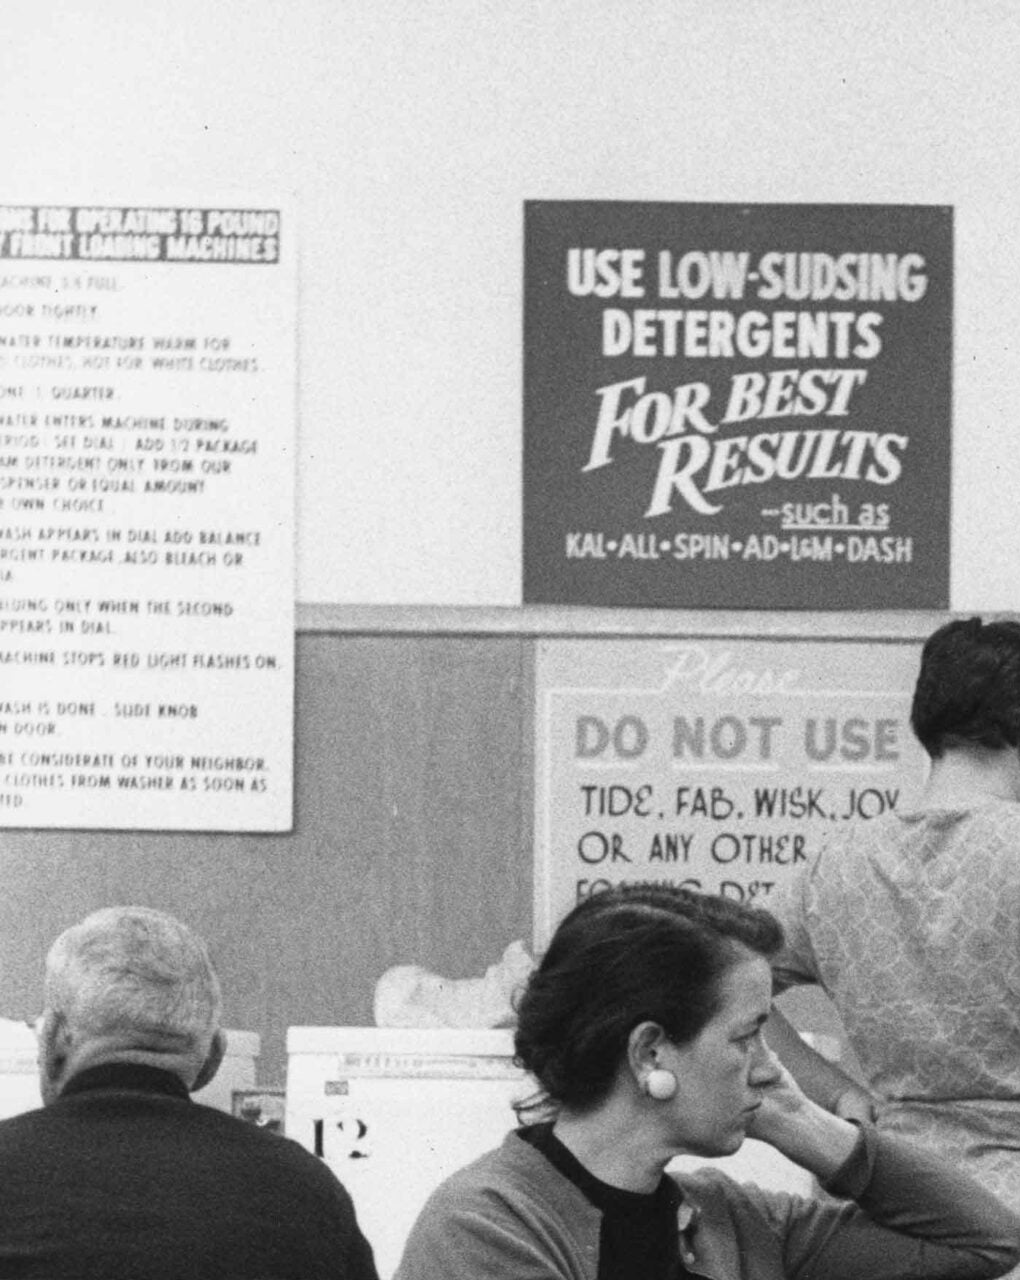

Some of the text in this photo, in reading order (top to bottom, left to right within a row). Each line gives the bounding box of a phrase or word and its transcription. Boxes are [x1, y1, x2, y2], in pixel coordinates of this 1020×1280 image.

[77, 208, 178, 235] OPERATING
[208, 210, 278, 238] POUND
[11, 232, 74, 259] FRONT
[79, 234, 161, 260] LOADING
[166, 235, 278, 262] MACHINES
[566, 248, 929, 302] USE LOW-SUDSING
[48, 334, 145, 350] TEMPERATURE
[152, 336, 197, 350] WARM
[203, 336, 231, 351] FOR
[602, 308, 884, 359] DETERGENTS
[151, 356, 193, 371] WHITE
[44, 414, 95, 429] ENTERS
[101, 415, 166, 430] MACHINE
[174, 416, 229, 432] DURING
[582, 368, 868, 472] FOR BEST
[196, 439, 259, 454] PACKAGE
[25, 455, 102, 472] DETERGENT
[107, 457, 145, 473] ONLY
[153, 458, 195, 473] FROM
[201, 459, 232, 474] OUR
[644, 429, 908, 519] RESULTS
[68, 477, 88, 493] OR
[144, 479, 205, 495] AMOUNT
[858, 502, 891, 528] as
[38, 526, 99, 542] APPEARS
[106, 528, 121, 543] IN
[128, 529, 158, 544] DIAL
[164, 530, 193, 545] ADD
[199, 530, 261, 547] BALANCE
[165, 551, 217, 566] BLEACH
[223, 552, 244, 567] OR
[54, 599, 92, 615] ONLY
[98, 599, 140, 615] WHEN
[147, 600, 171, 616] THE
[177, 600, 234, 617] SECOND
[60, 619, 75, 635] IN
[63, 650, 106, 668] STOPS
[113, 652, 142, 669] RED
[148, 652, 188, 670] LIGHT
[193, 652, 251, 671] FLASHES
[655, 643, 801, 694] Please
[158, 703, 199, 720] KNOB
[575, 714, 901, 763] DO NOT USE
[21, 752, 115, 769] CONSIDERATE
[121, 753, 138, 770] OF
[146, 754, 185, 771] YOUR
[71, 773, 112, 790] FROM
[117, 775, 174, 792] WASHER
[180, 775, 198, 792] AS
[203, 776, 246, 793] SOON
[251, 776, 269, 793] AS
[577, 832, 807, 866] OR ANY OTHER
